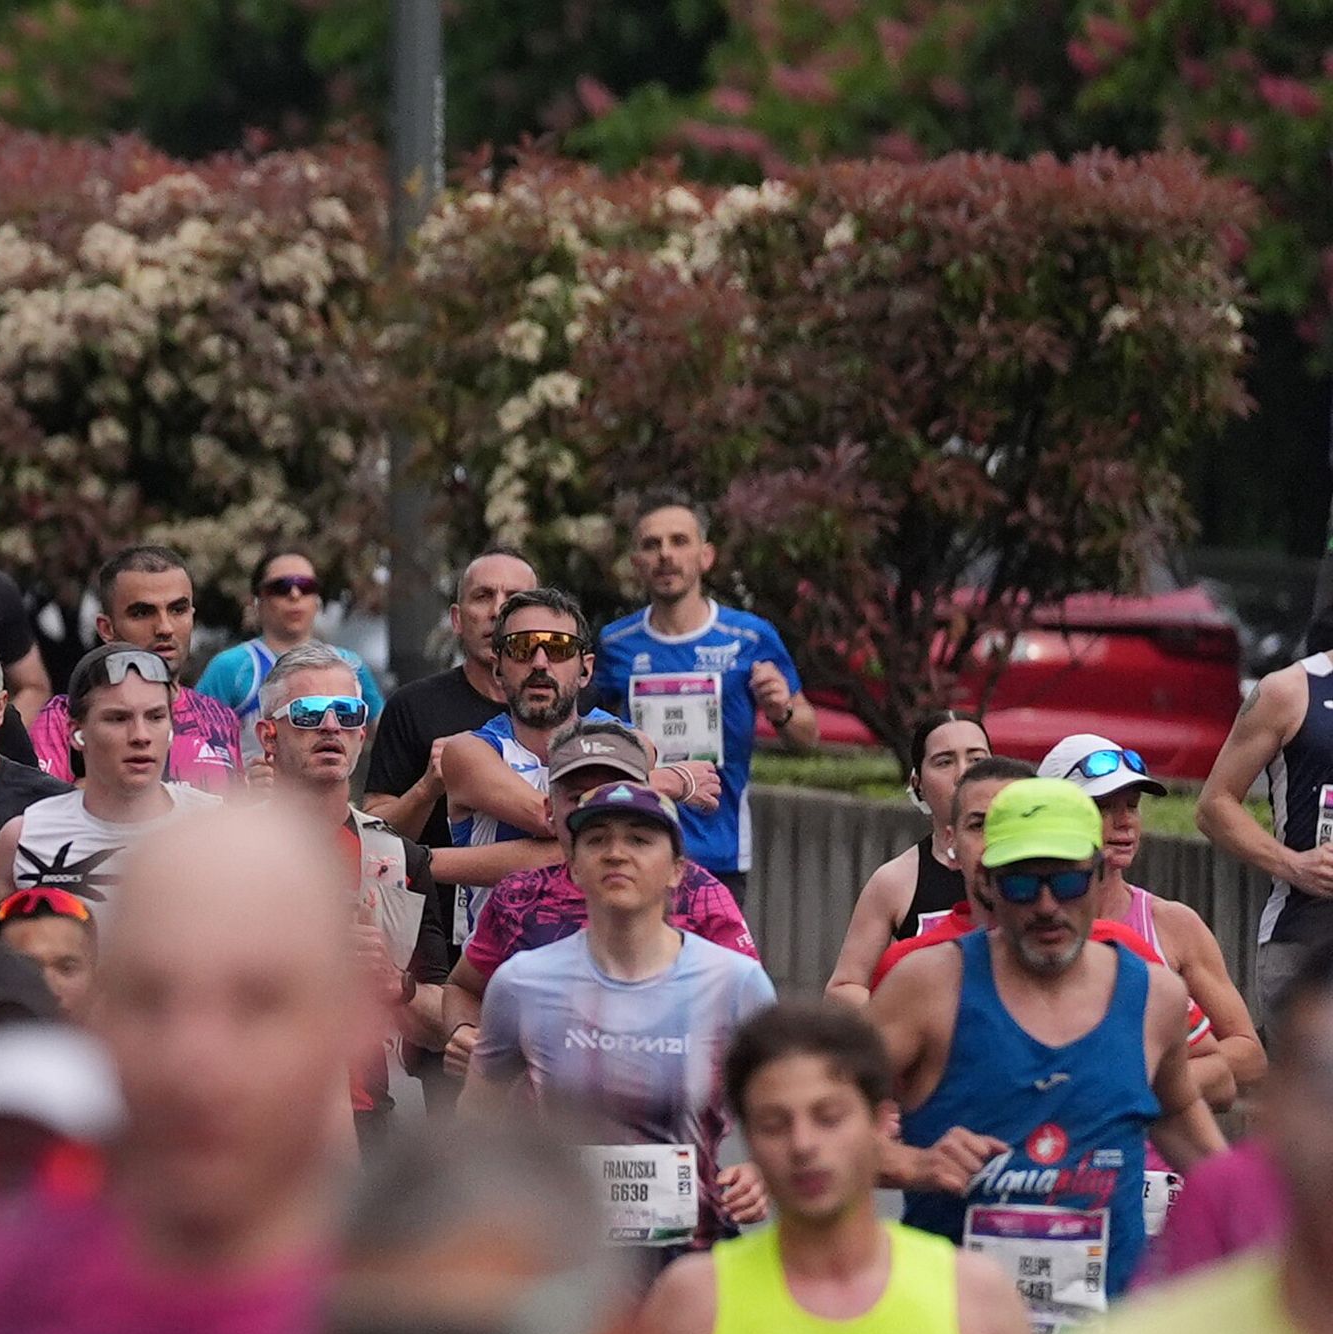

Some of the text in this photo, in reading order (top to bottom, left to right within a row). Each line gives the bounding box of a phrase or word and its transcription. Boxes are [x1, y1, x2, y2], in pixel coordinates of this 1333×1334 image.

[41, 873, 83, 883] BROOKS
[603, 1160, 658, 1179] FRANZISKA
[611, 1183, 649, 1202] 6638
